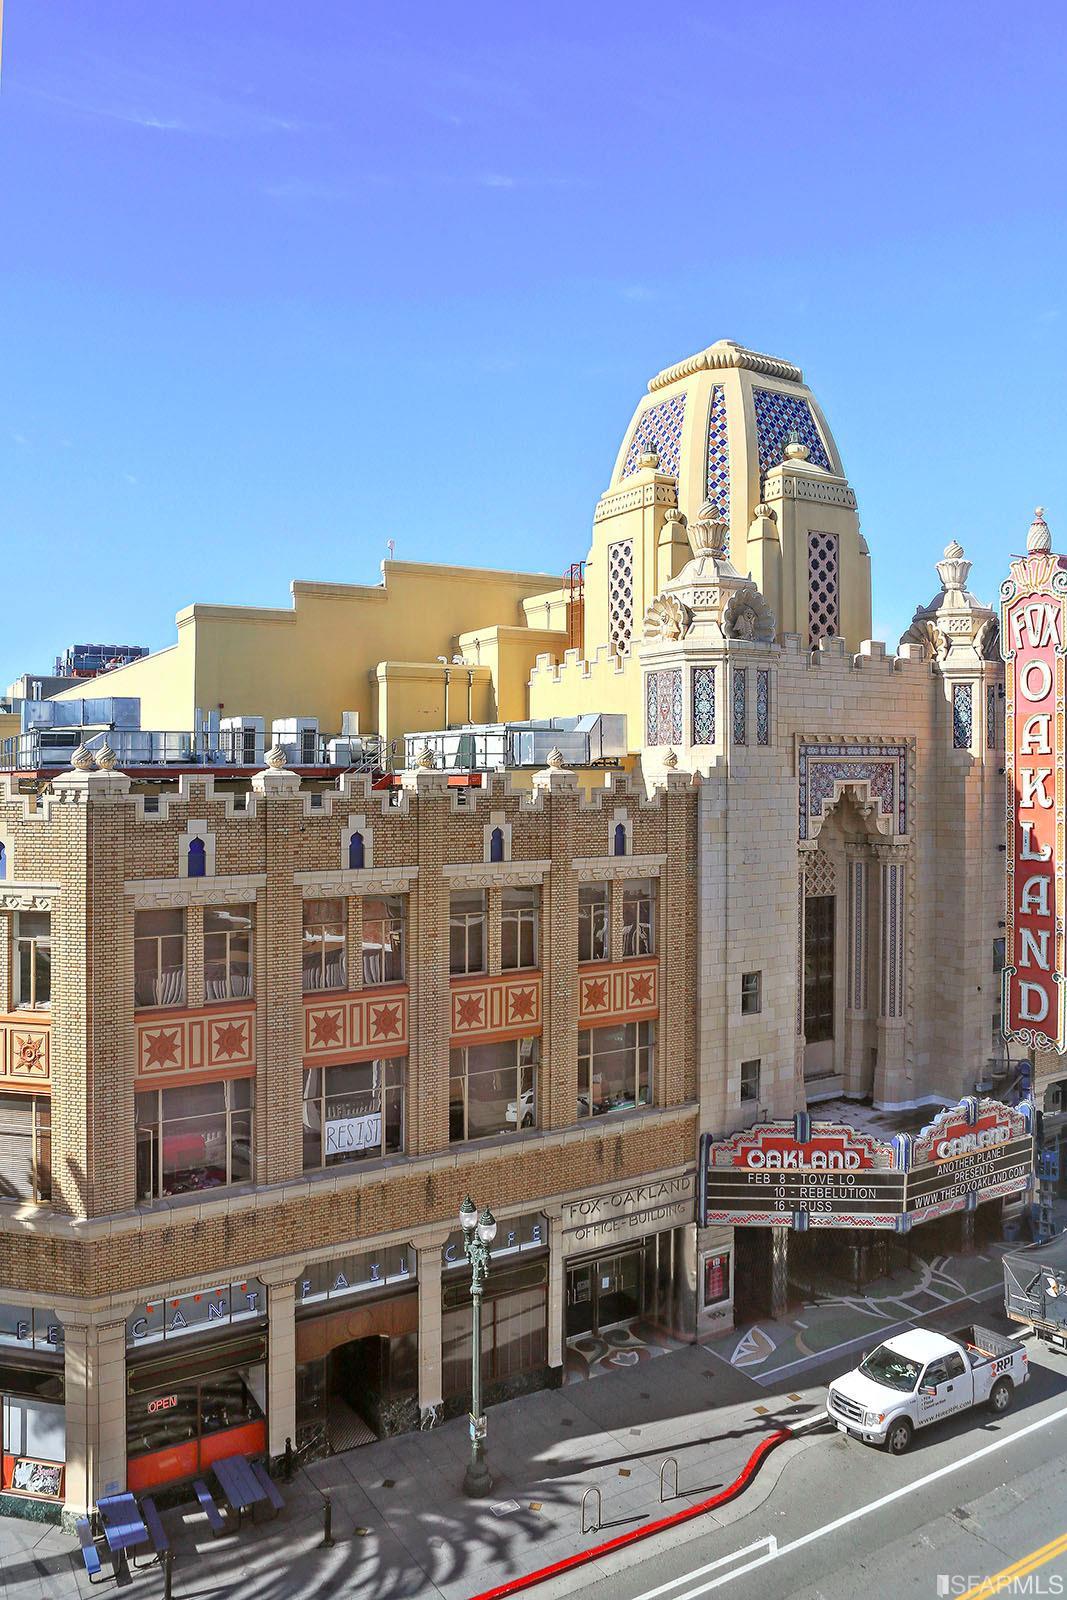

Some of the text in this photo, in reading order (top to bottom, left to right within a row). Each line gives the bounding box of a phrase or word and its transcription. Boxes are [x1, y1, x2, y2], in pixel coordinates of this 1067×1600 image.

[1011, 602, 1061, 650] FOX
[1018, 659, 1053, 1022] OAKLAND
[326, 1118, 381, 1151] RESIST
[747, 1149, 861, 1169] OAKLAND
[937, 1146, 1006, 1176] ANOTHER PLANET
[954, 1162, 995, 1183] PRESENTS
[747, 1173, 771, 1184] FEB
[779, 1173, 786, 1185] 8
[801, 1173, 834, 1186] TOVE
[839, 1174, 856, 1186] LO
[774, 1187, 786, 1198] 10
[800, 1187, 877, 1199] REBELUTION
[914, 1165, 1025, 1209] WWW.THEFOXOAKLAND.COM
[570, 1177, 690, 1218] FOX-OAKLAND
[774, 1200, 786, 1211] 16
[800, 1201, 833, 1212] RUSS
[575, 1204, 686, 1240] OFFICE-BUILDING
[131, 1225, 542, 1339] CANT FAIL CFE
[996, 1355, 1014, 1373] RPI
[147, 1394, 178, 1414] OPEN
